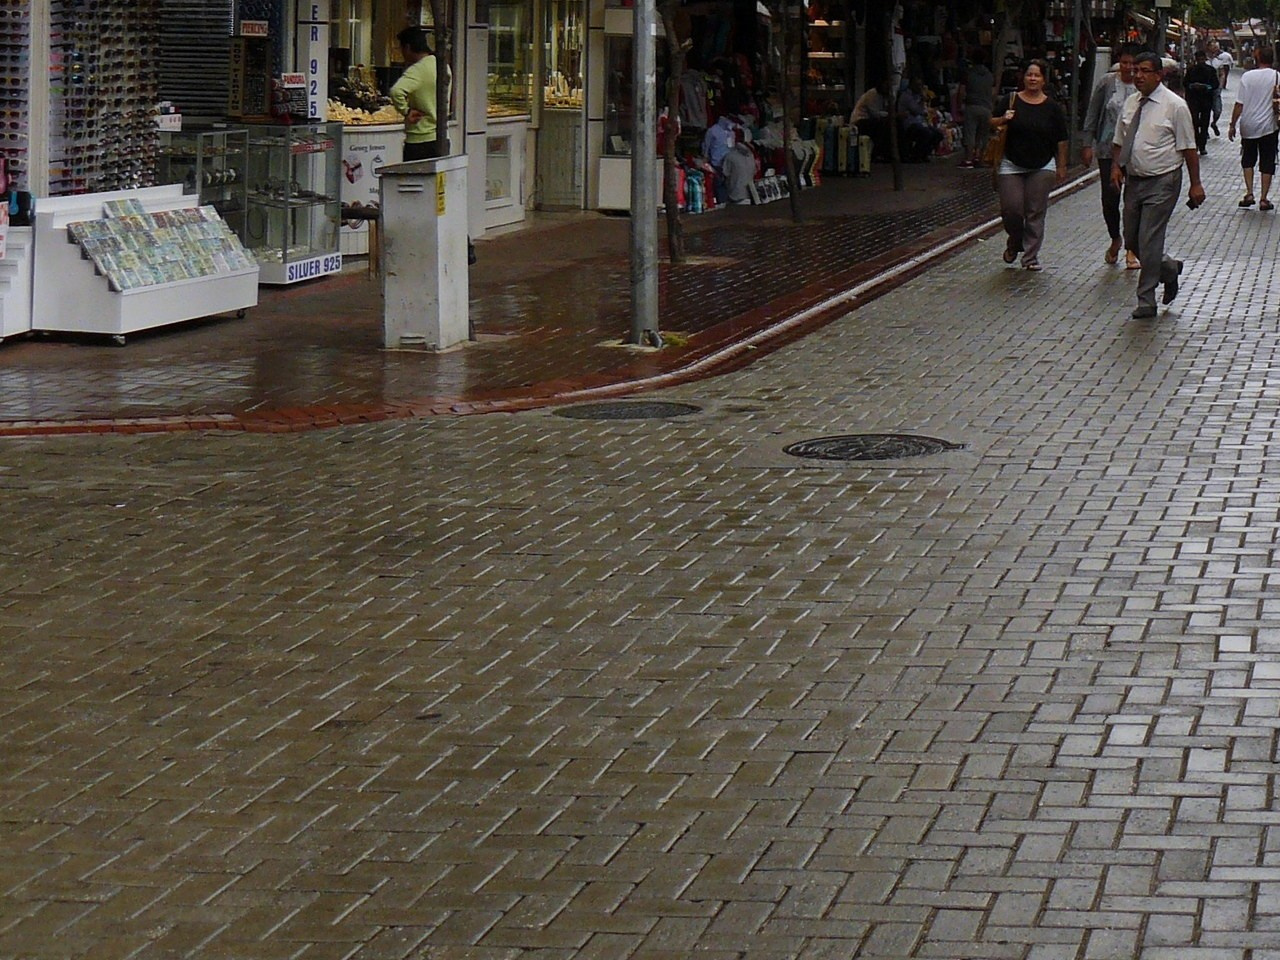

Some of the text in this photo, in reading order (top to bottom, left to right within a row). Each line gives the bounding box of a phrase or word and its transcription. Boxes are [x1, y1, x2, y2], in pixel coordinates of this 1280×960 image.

[309, 59, 318, 117] 925
[288, 254, 341, 281] SILVER 925
